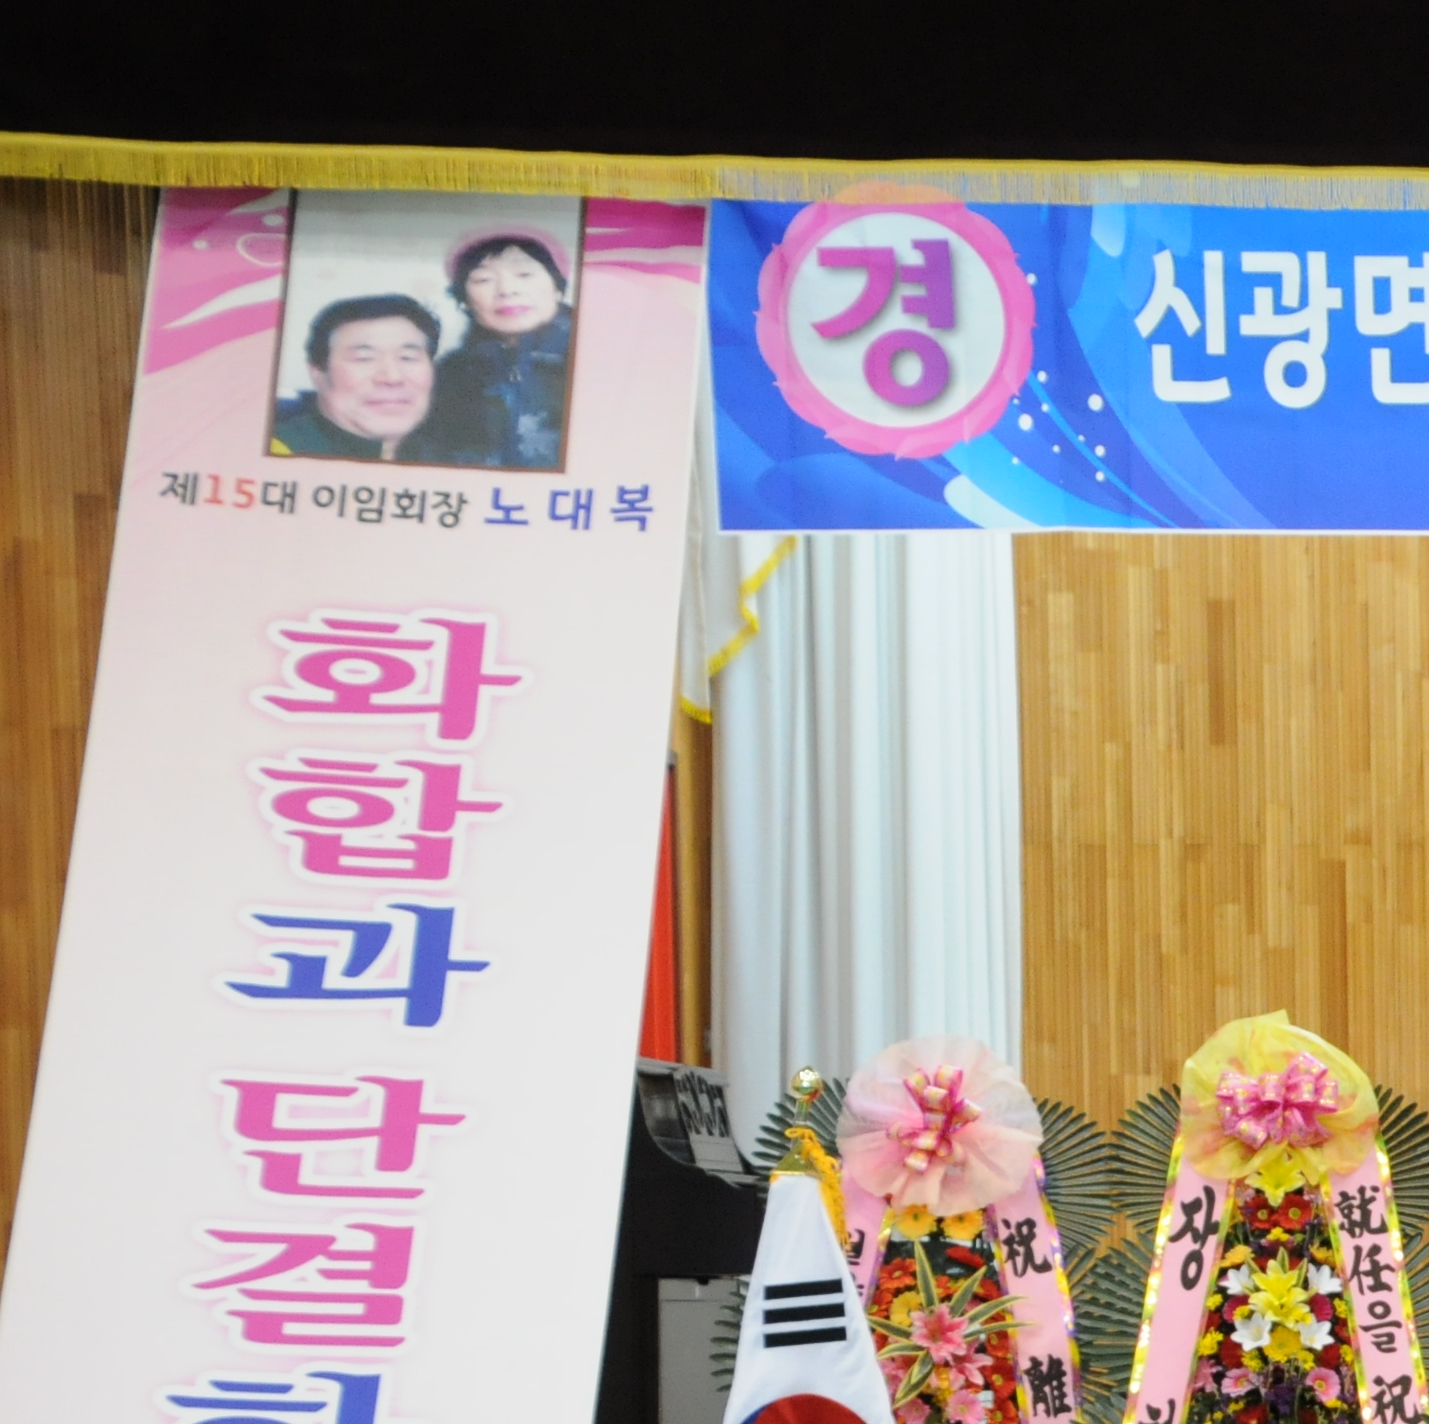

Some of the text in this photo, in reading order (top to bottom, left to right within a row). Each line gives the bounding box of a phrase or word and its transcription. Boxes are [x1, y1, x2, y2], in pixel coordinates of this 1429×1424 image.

[810, 239, 955, 408] 경
[160, 472, 297, 516] 제15대
[311, 485, 468, 528] 이임회장
[223, 617, 523, 1027] 화합과
[1001, 1215, 1053, 1279] 祝
